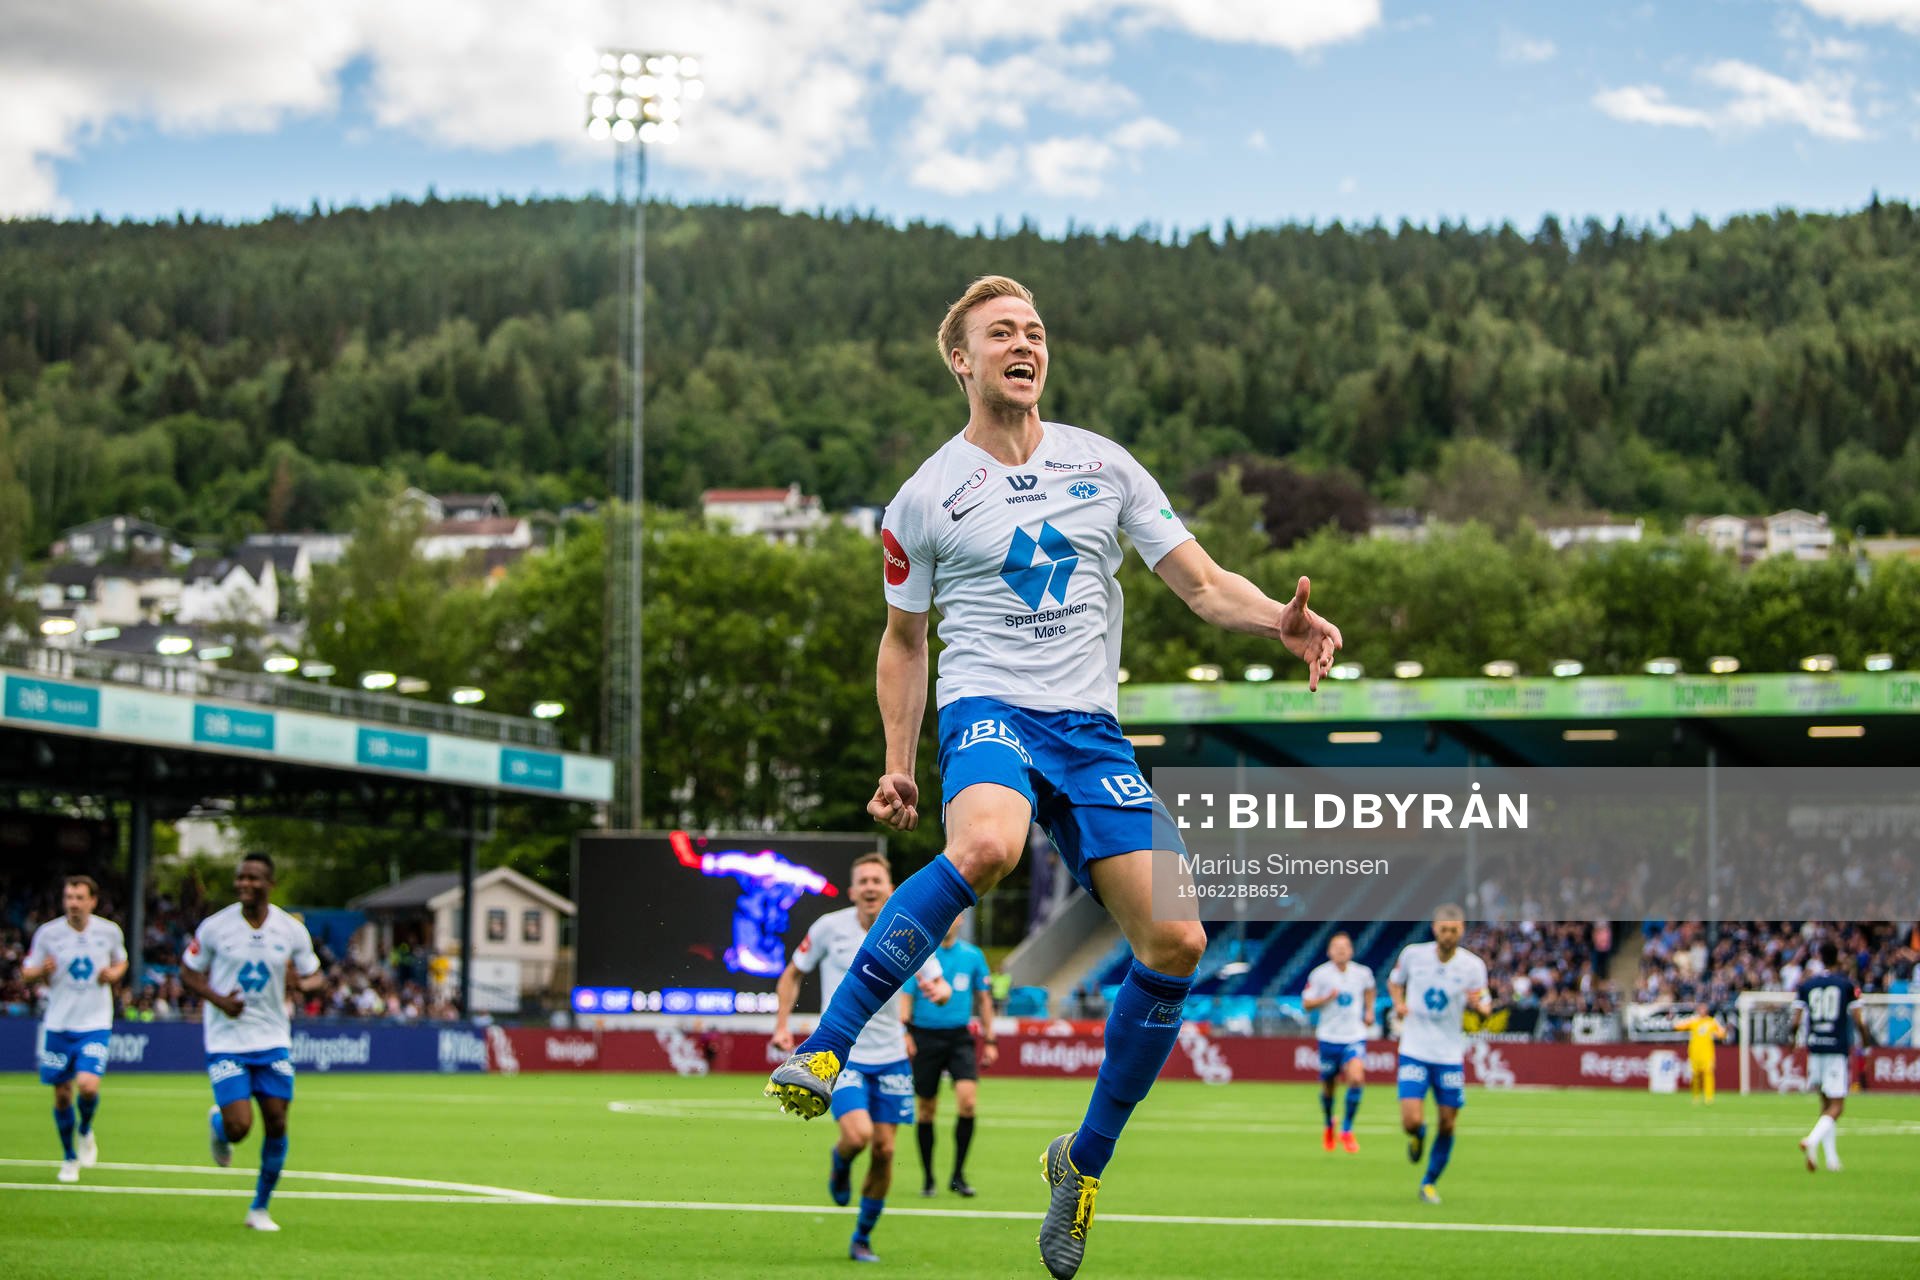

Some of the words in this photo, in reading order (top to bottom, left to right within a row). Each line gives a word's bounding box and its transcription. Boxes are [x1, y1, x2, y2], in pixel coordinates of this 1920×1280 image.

[1044, 460, 1083, 470] sport
[942, 479, 973, 509] sport
[1005, 493, 1047, 505] wenaas
[1005, 603, 1087, 628] Sparebanken
[1035, 624, 1066, 639] Møre
[883, 939, 910, 965] AKER
